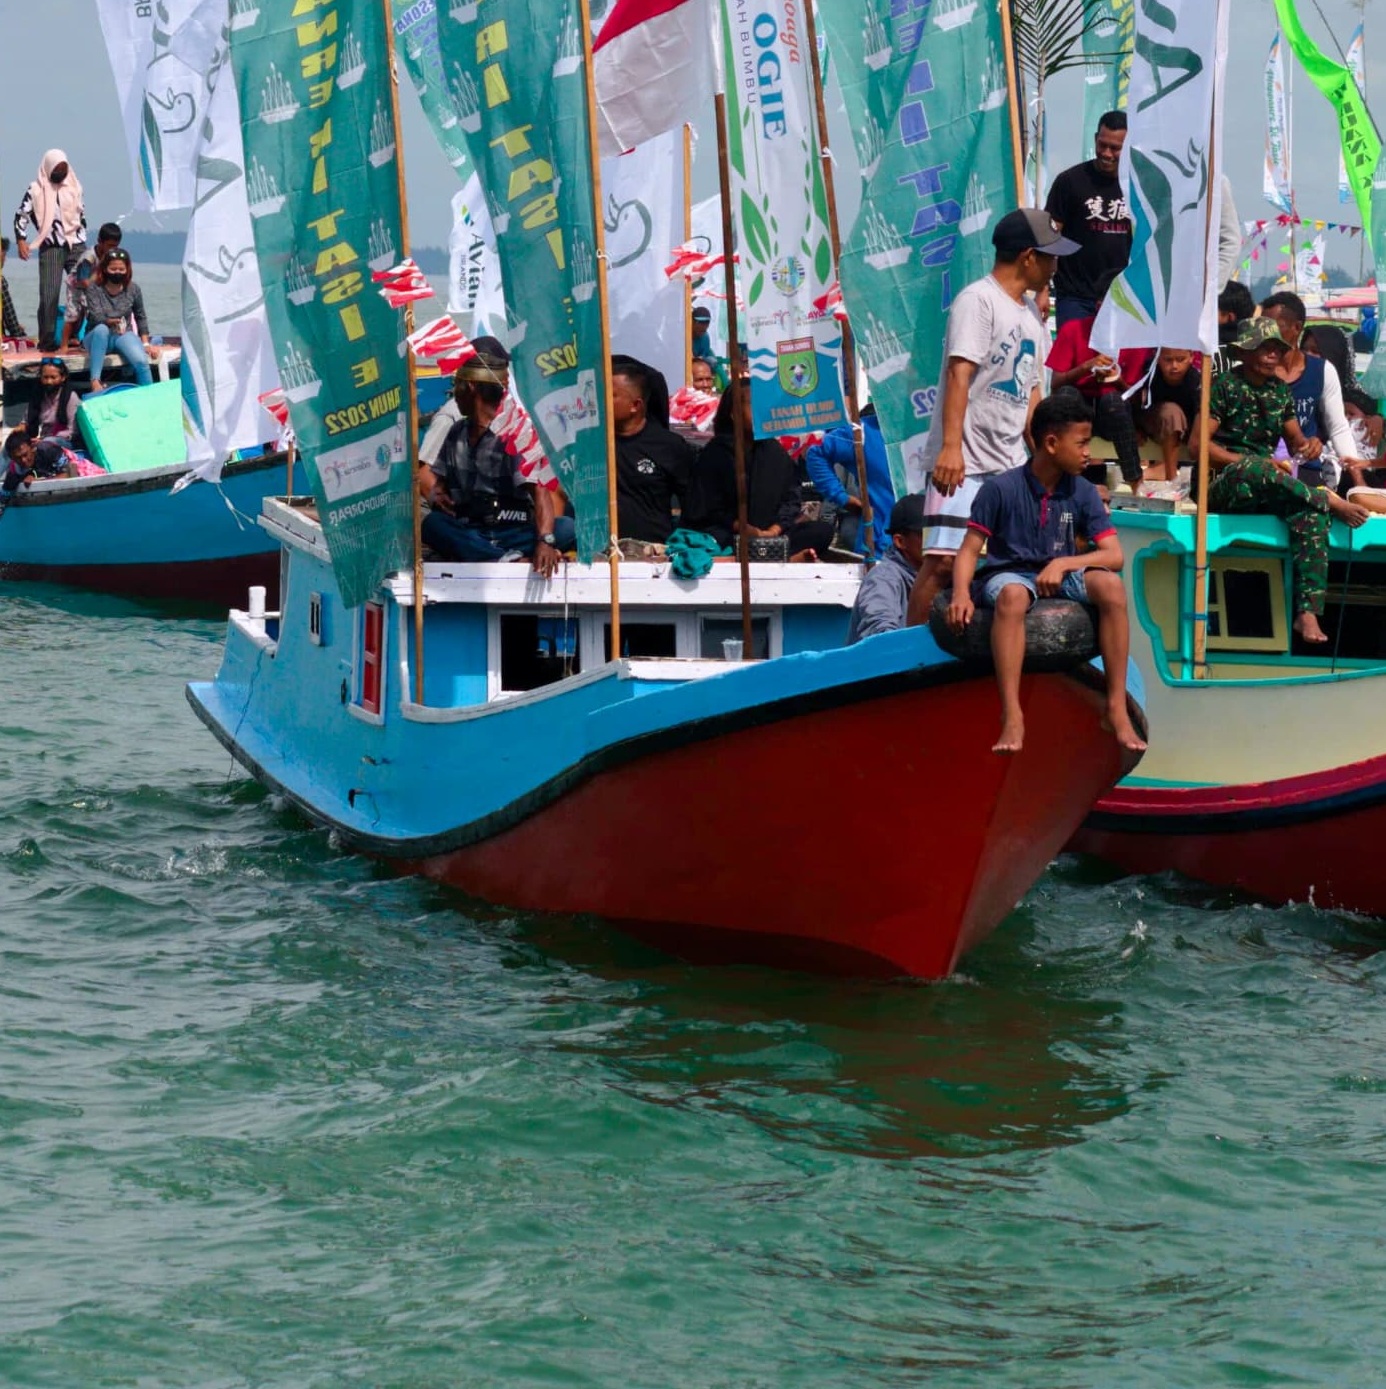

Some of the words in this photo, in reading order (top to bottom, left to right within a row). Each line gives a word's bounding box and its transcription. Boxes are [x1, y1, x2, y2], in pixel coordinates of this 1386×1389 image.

[739, 30, 758, 105] BUMBU
[752, 11, 788, 142] OGIE
[468, 232, 486, 310] Avian
